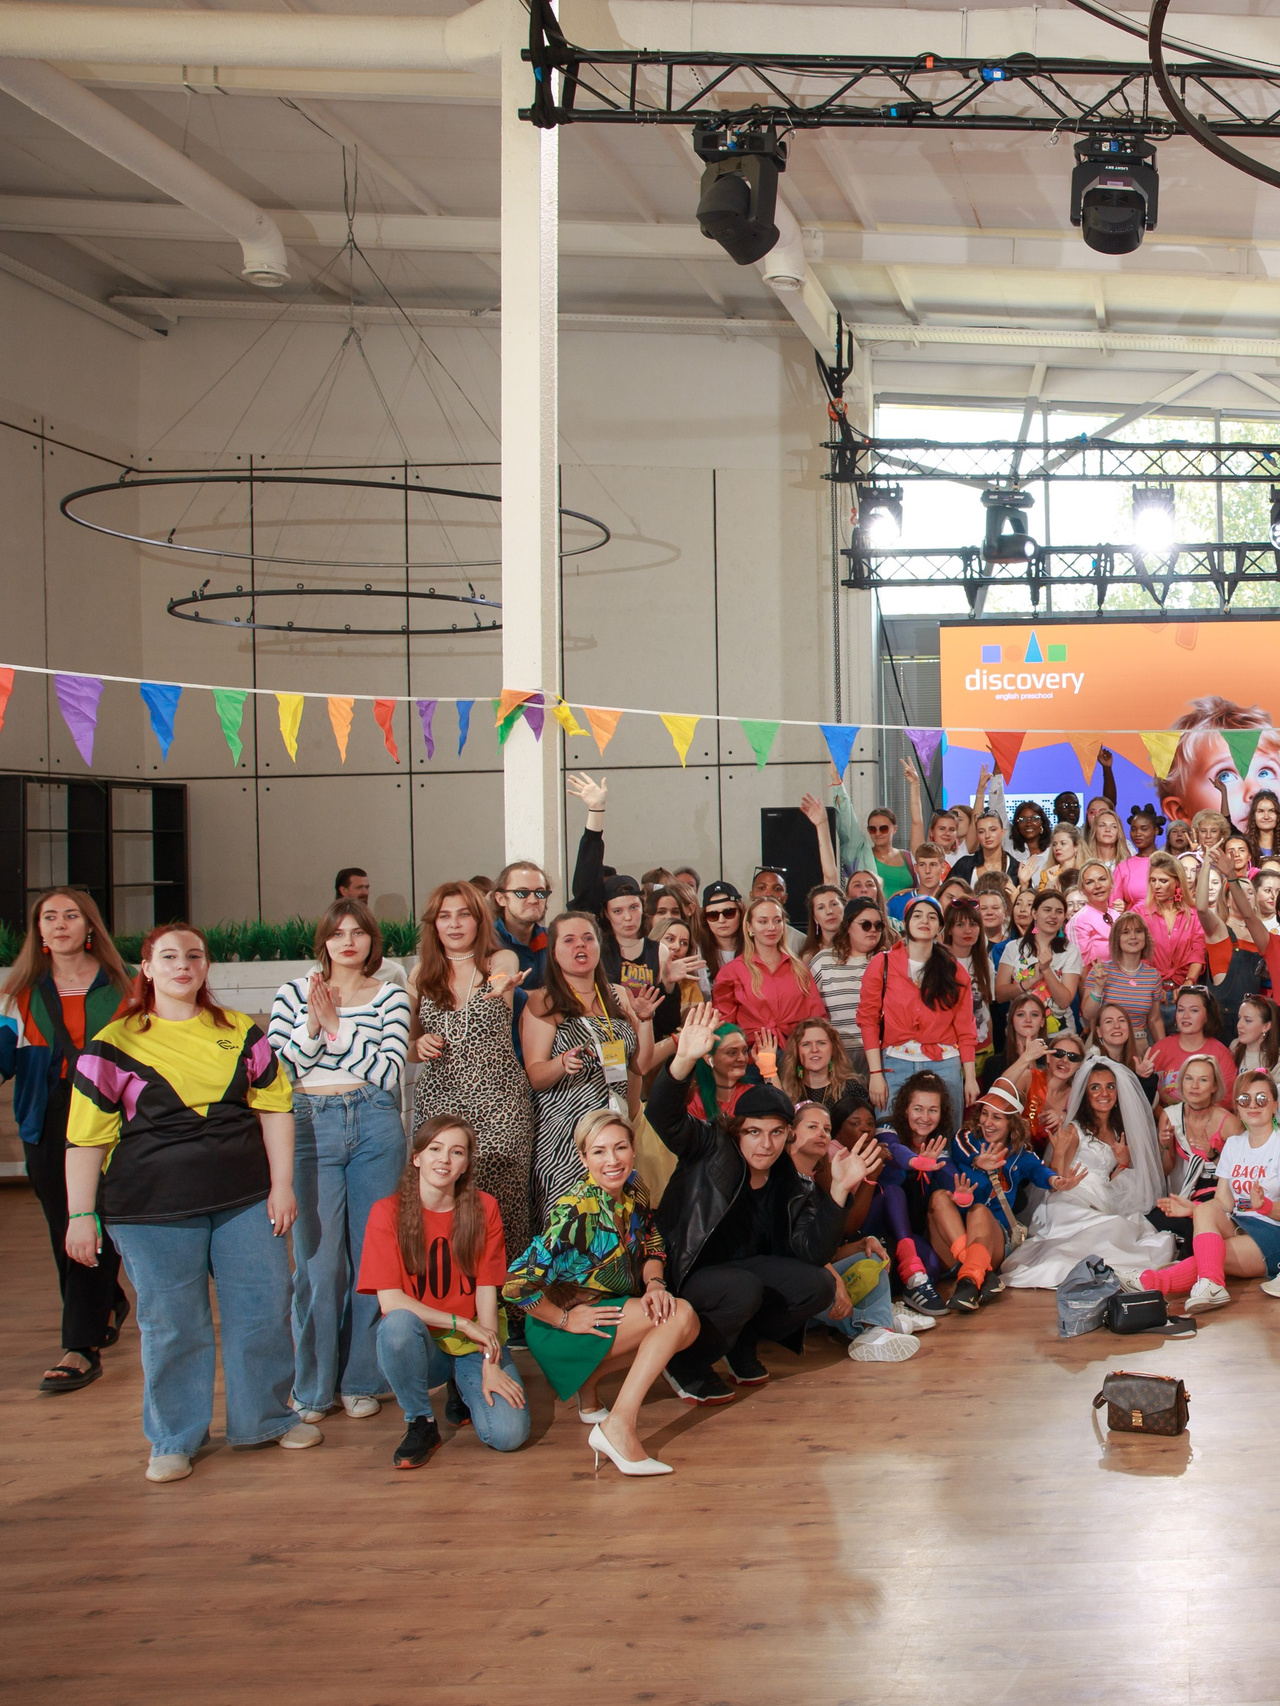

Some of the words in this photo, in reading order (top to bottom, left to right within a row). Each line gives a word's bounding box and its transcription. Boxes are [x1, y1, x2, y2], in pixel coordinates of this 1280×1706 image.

[965, 668, 1085, 695] discovery
[995, 692, 1020, 702] english
[1020, 692, 1054, 701] preschool
[1231, 1163, 1266, 1179] BACK
